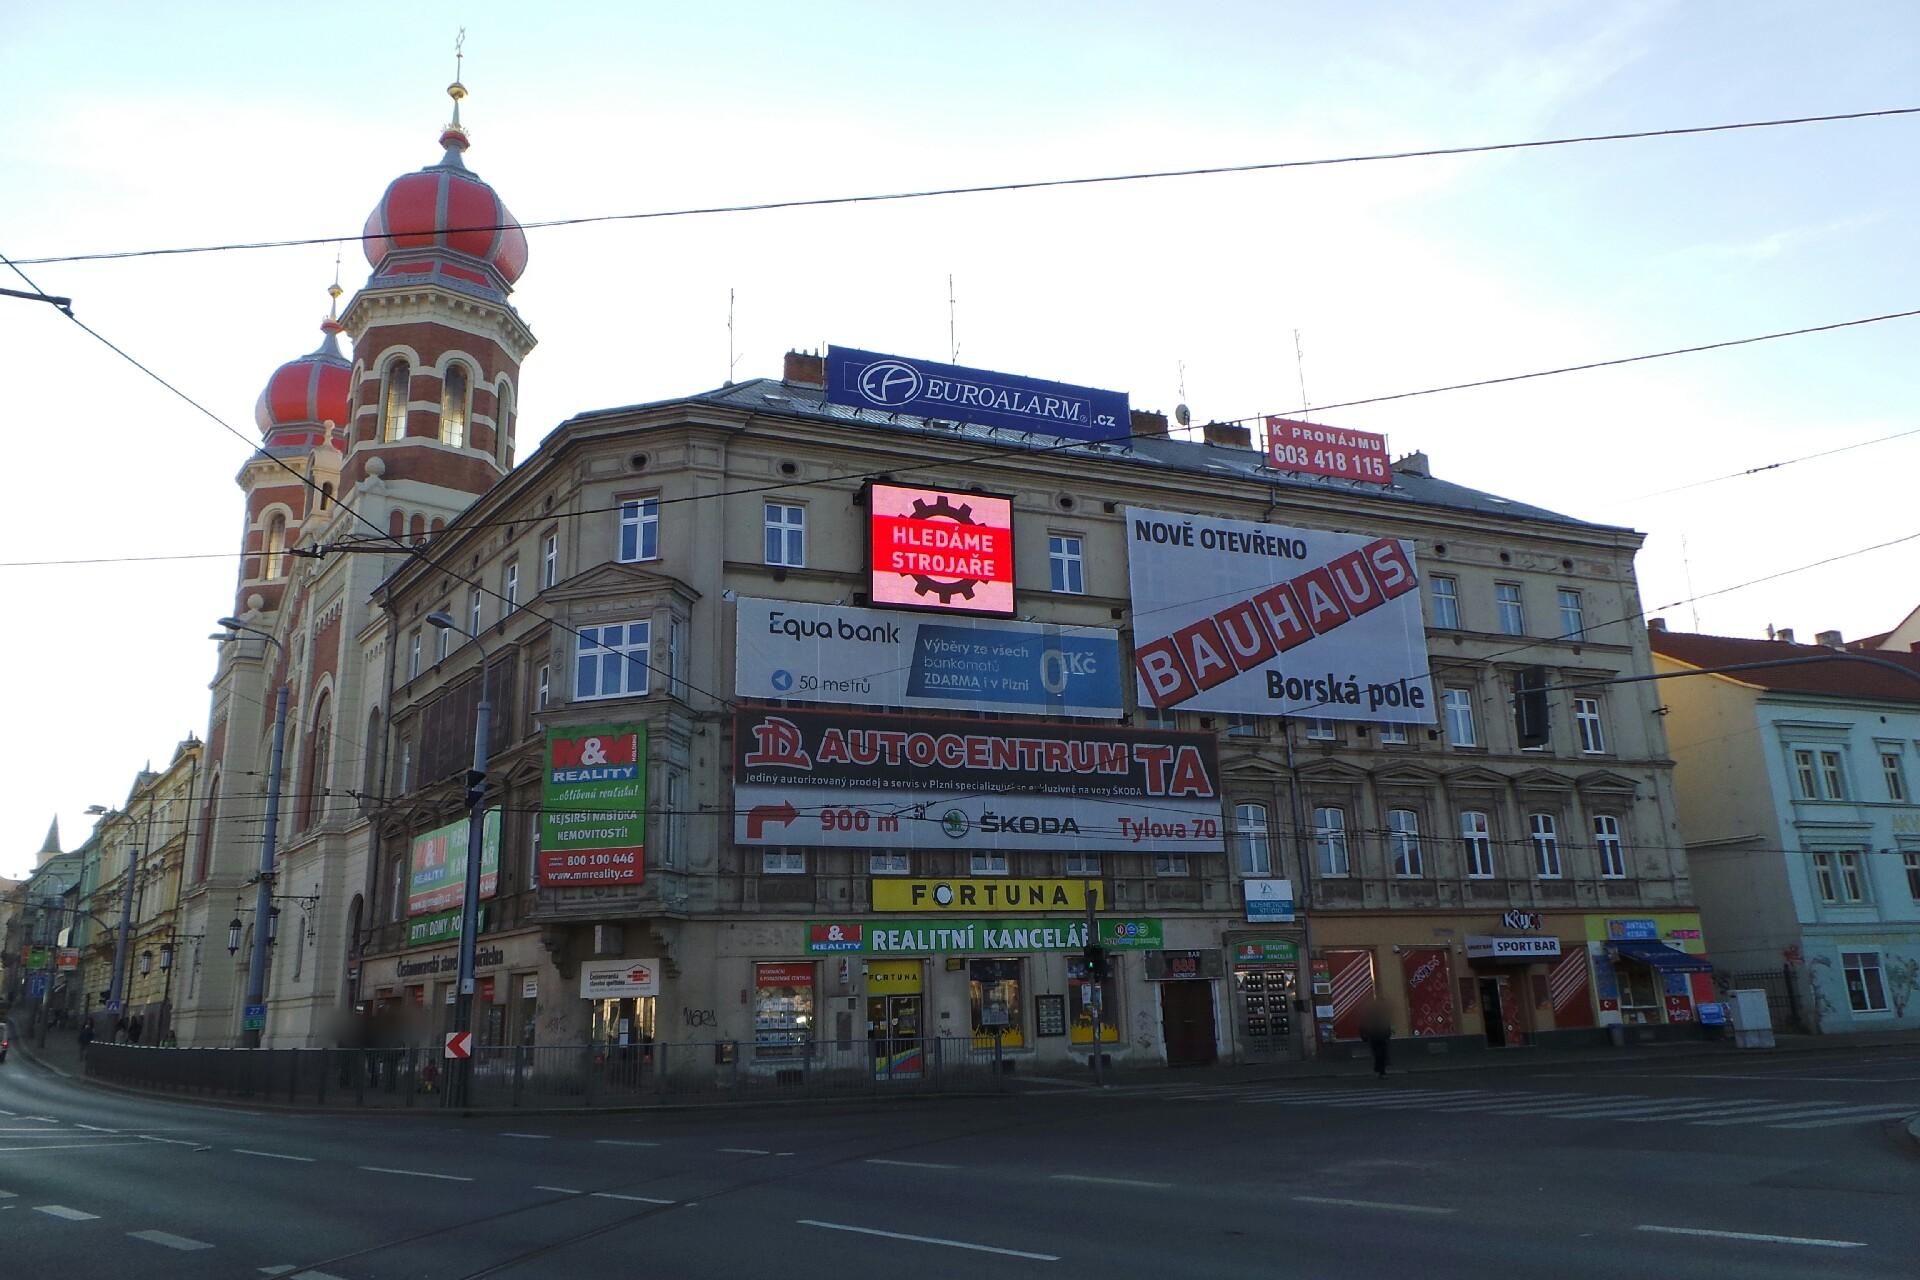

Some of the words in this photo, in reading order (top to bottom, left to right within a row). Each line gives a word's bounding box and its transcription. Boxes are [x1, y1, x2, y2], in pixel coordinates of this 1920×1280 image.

[1272, 425, 1282, 436] K
[1292, 427, 1381, 450] PRONÁJMU
[1274, 443, 1308, 466] 603
[1315, 449, 1346, 471] 418
[1353, 455, 1383, 476] 115
[892, 525, 994, 552] HLEDÁME
[1135, 520, 1194, 547] NOVĚ
[1200, 528, 1307, 560] OTEVŘENO
[892, 551, 995, 576] STROJAŘE
[769, 611, 832, 642] Equa
[838, 617, 900, 644] bank
[1141, 544, 1405, 698] BAUHAUS
[923, 638, 969, 656] Výběry
[973, 644, 988, 656] ze
[992, 645, 1029, 658] všech
[923, 655, 1000, 673] bankomatů
[1040, 648, 1068, 695] 0
[1069, 651, 1097, 675] Kč
[799, 675, 818, 690] 50
[823, 677, 871, 694] metrů
[924, 672, 981, 689] ZDARMA
[990, 679, 999, 689] v
[1266, 670, 1361, 705] Borská
[1368, 678, 1425, 712] pole
[553, 767, 634, 782] REALITY
[816, 727, 1129, 775] AUTOCENTRUM
[1133, 743, 1214, 798] TA
[745, 772, 778, 785] Jediný
[781, 775, 846, 787] autorizovaný
[849, 777, 881, 789] prodej
[883, 779, 889, 787] a
[891, 778, 922, 789] servis
[1078, 786, 1089, 794] na
[1091, 787, 1111, 797] vozy
[1112, 785, 1143, 796] ŠKODA
[821, 809, 869, 832] 900
[877, 814, 899, 832] m
[980, 811, 1081, 834] ŠKODA
[1118, 817, 1186, 843] Tylova
[1191, 819, 1216, 839] 70
[557, 826, 628, 841] NEMOVITOSTÍ!
[567, 855, 586, 866] 800
[589, 854, 609, 865] 100
[612, 853, 634, 864] 446
[548, 868, 634, 880] www.mmreality.cz
[911, 882, 1068, 907] FORTUNA
[812, 943, 861, 951] REALITY
[872, 923, 975, 951] REALITNÍ
[1497, 941, 1531, 952] SPORT
[1535, 940, 1556, 951] BAR
[869, 973, 917, 981] FORTUNA
